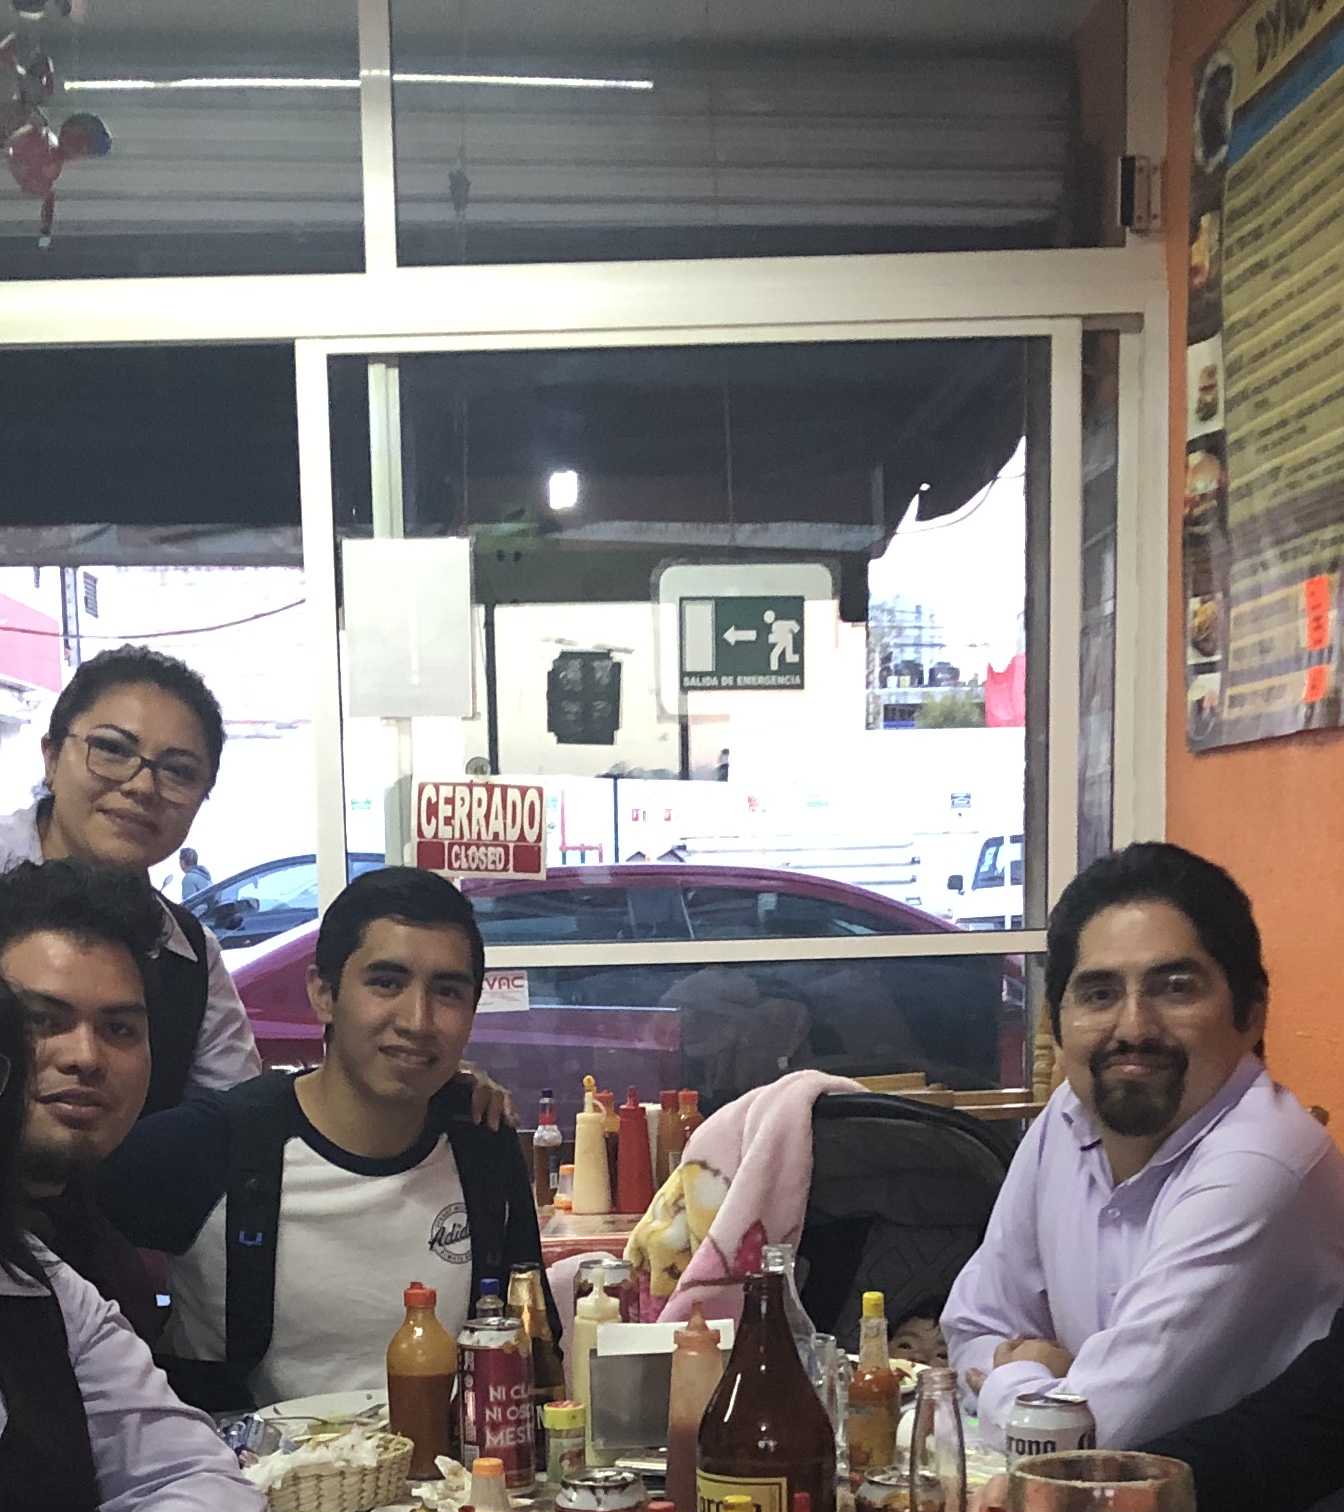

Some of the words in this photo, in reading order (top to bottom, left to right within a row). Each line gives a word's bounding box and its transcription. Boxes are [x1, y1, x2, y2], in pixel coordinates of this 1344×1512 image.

[683, 676, 719, 687] SALIDA
[721, 676, 734, 686] DE
[736, 675, 801, 687] EMERGENCIA
[420, 784, 541, 843] CERRADO
[451, 845, 505, 870] CLOSED
